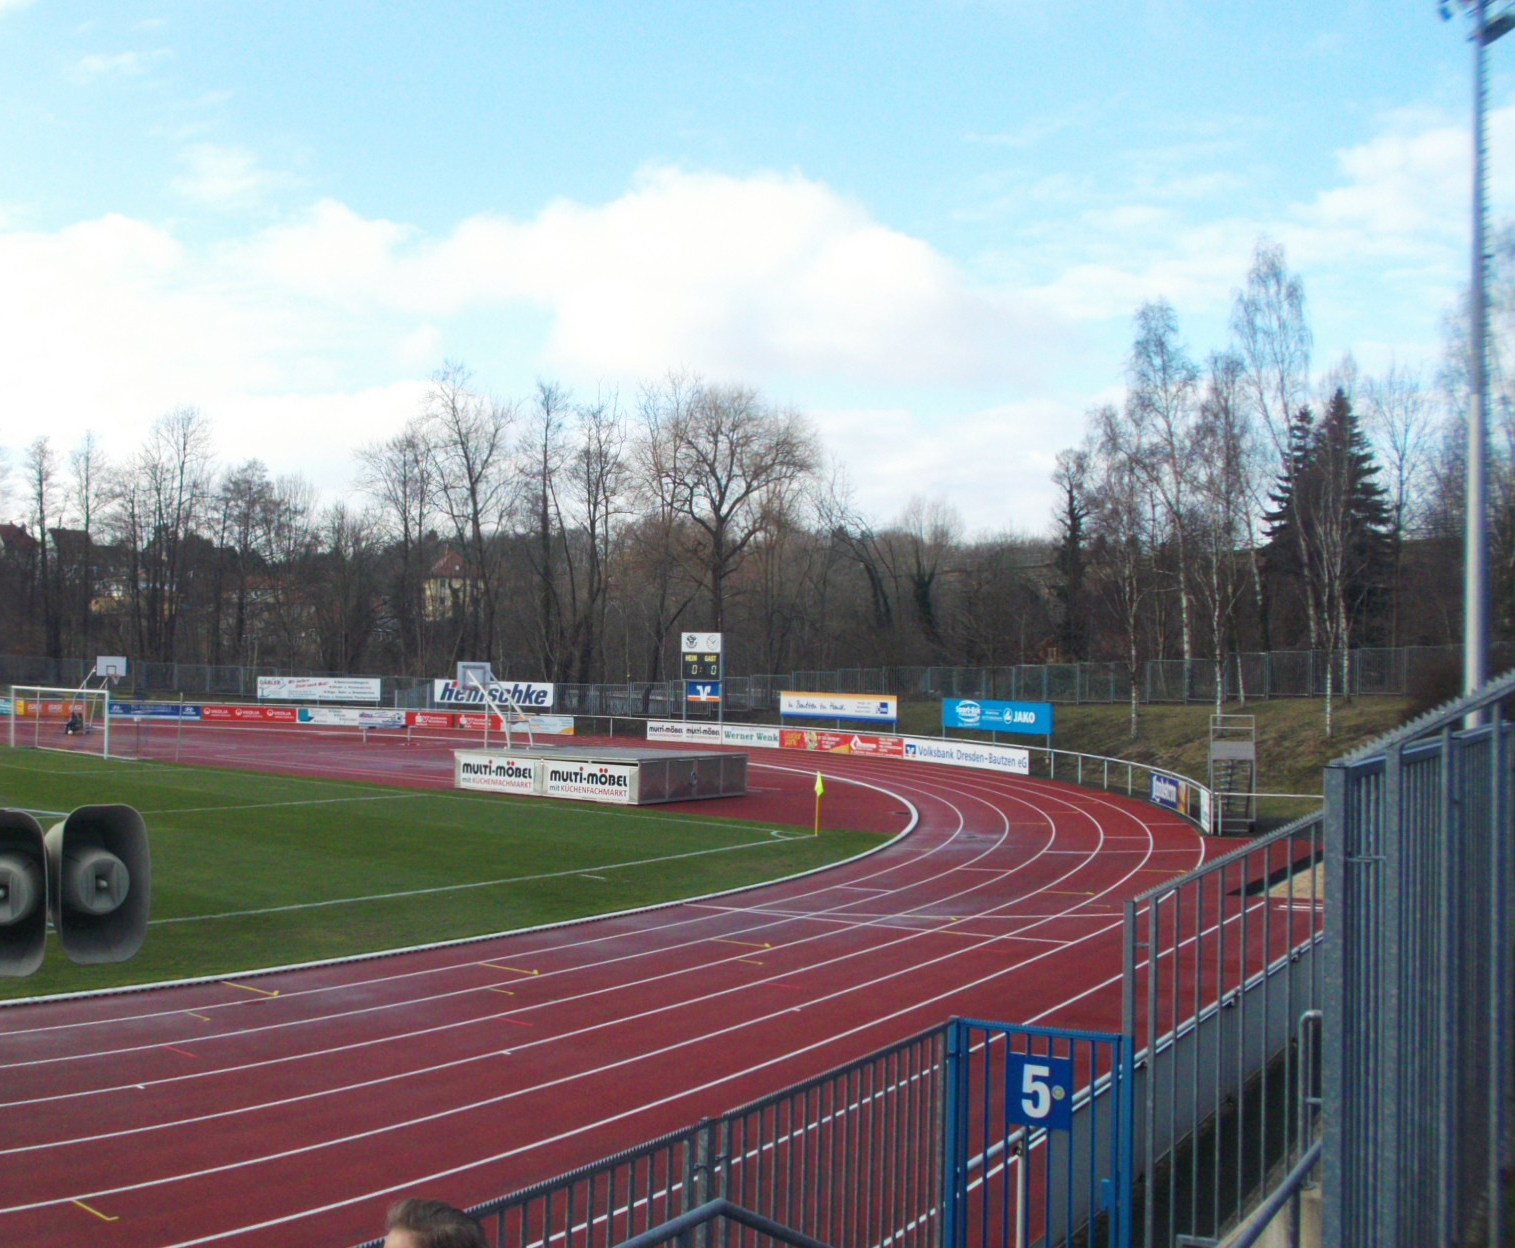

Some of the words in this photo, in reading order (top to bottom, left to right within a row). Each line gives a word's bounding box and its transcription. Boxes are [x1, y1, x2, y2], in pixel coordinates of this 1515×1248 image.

[1013, 710, 1036, 724] JAKO
[724, 730, 754, 741] Werner
[756, 732, 779, 743] Wenk
[917, 745, 954, 760] Volksbank
[1017, 756, 1028, 769] eG
[472, 776, 532, 789] KÜCHENFACHMARKT
[560, 784, 628, 798] KÜCHENFACHMARKT
[1021, 1063, 1051, 1119] 5
